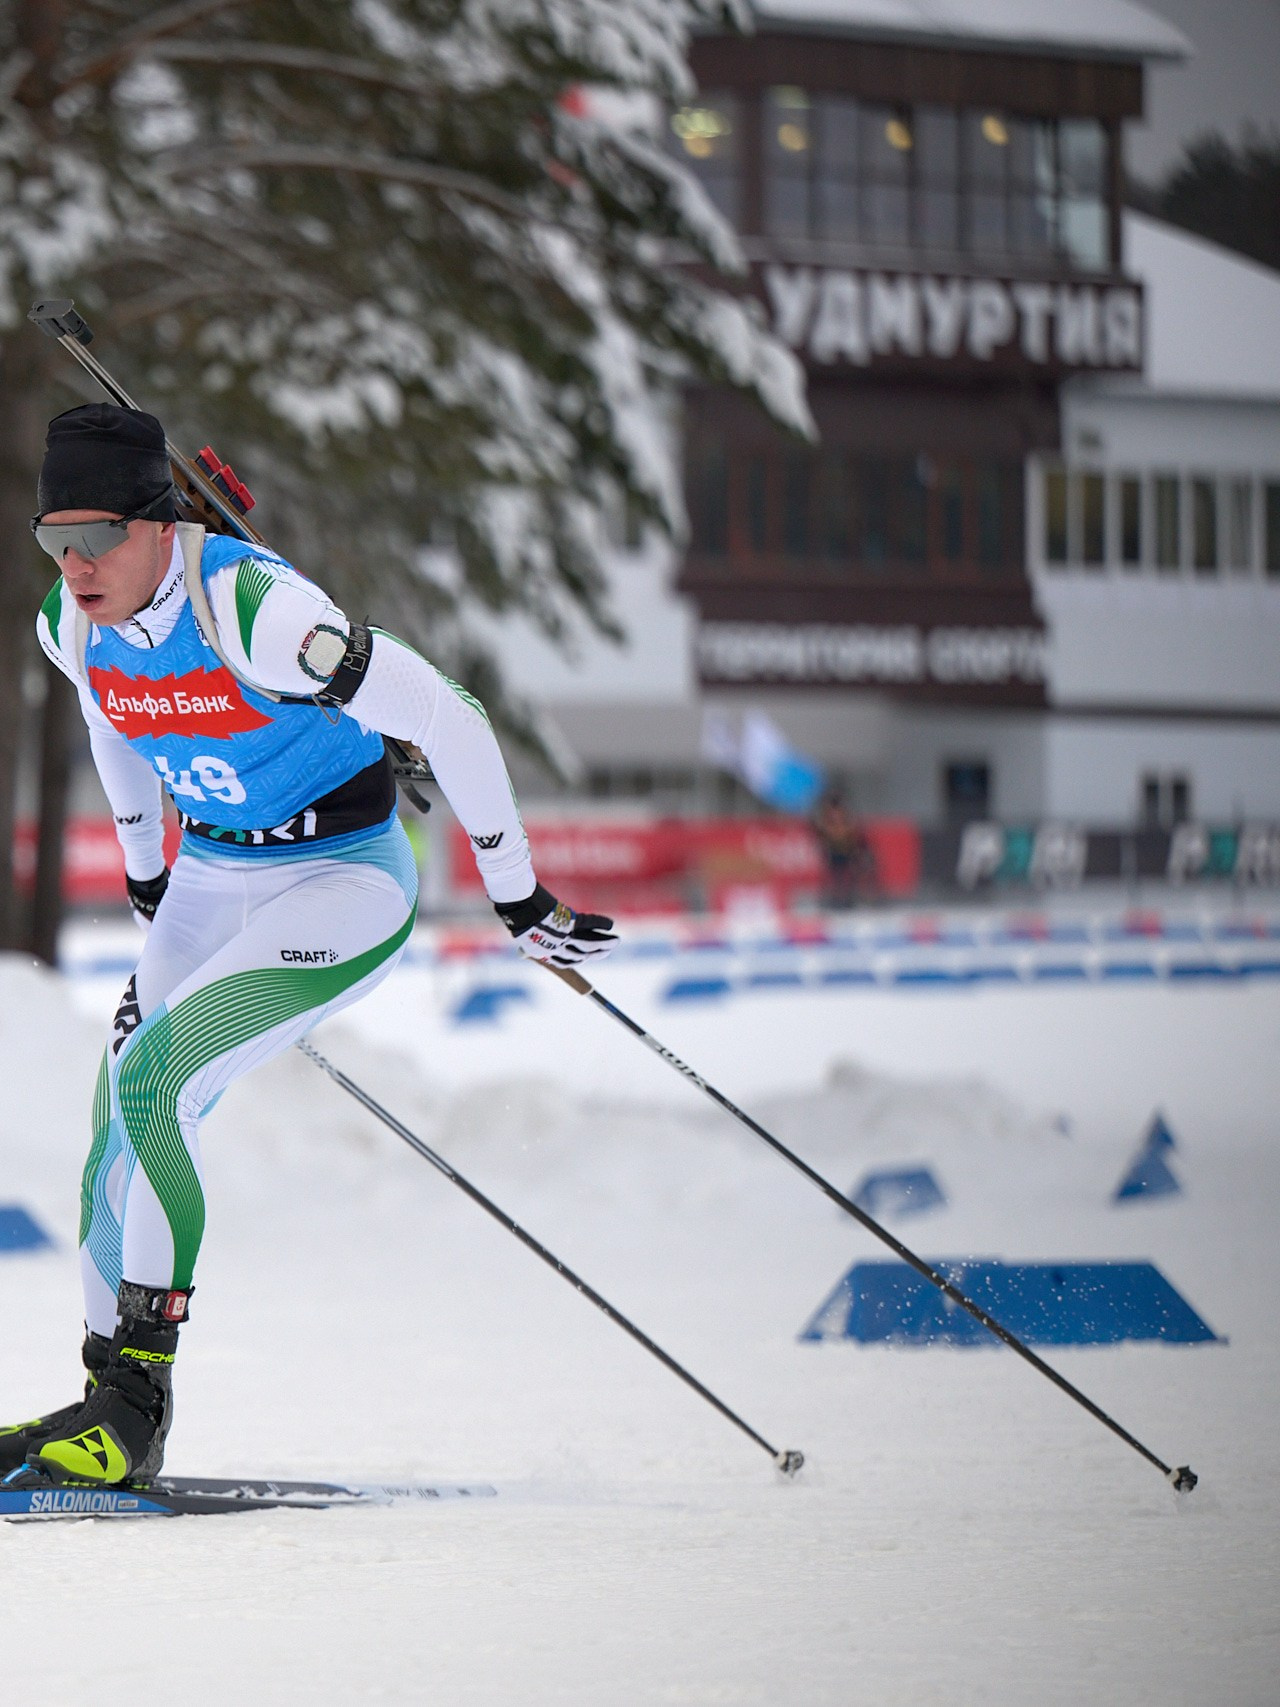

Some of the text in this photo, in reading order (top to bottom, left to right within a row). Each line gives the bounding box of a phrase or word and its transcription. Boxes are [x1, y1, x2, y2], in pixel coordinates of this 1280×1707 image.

[761, 263, 1143, 368] УДМУРТИЯ
[151, 579, 179, 612] CRAFT
[107, 688, 236, 721] Альфа Банк
[154, 755, 247, 805] 49
[280, 949, 327, 963] CRAFT
[119, 1346, 176, 1364] FISCHE
[29, 1491, 119, 1513] SALOMON
